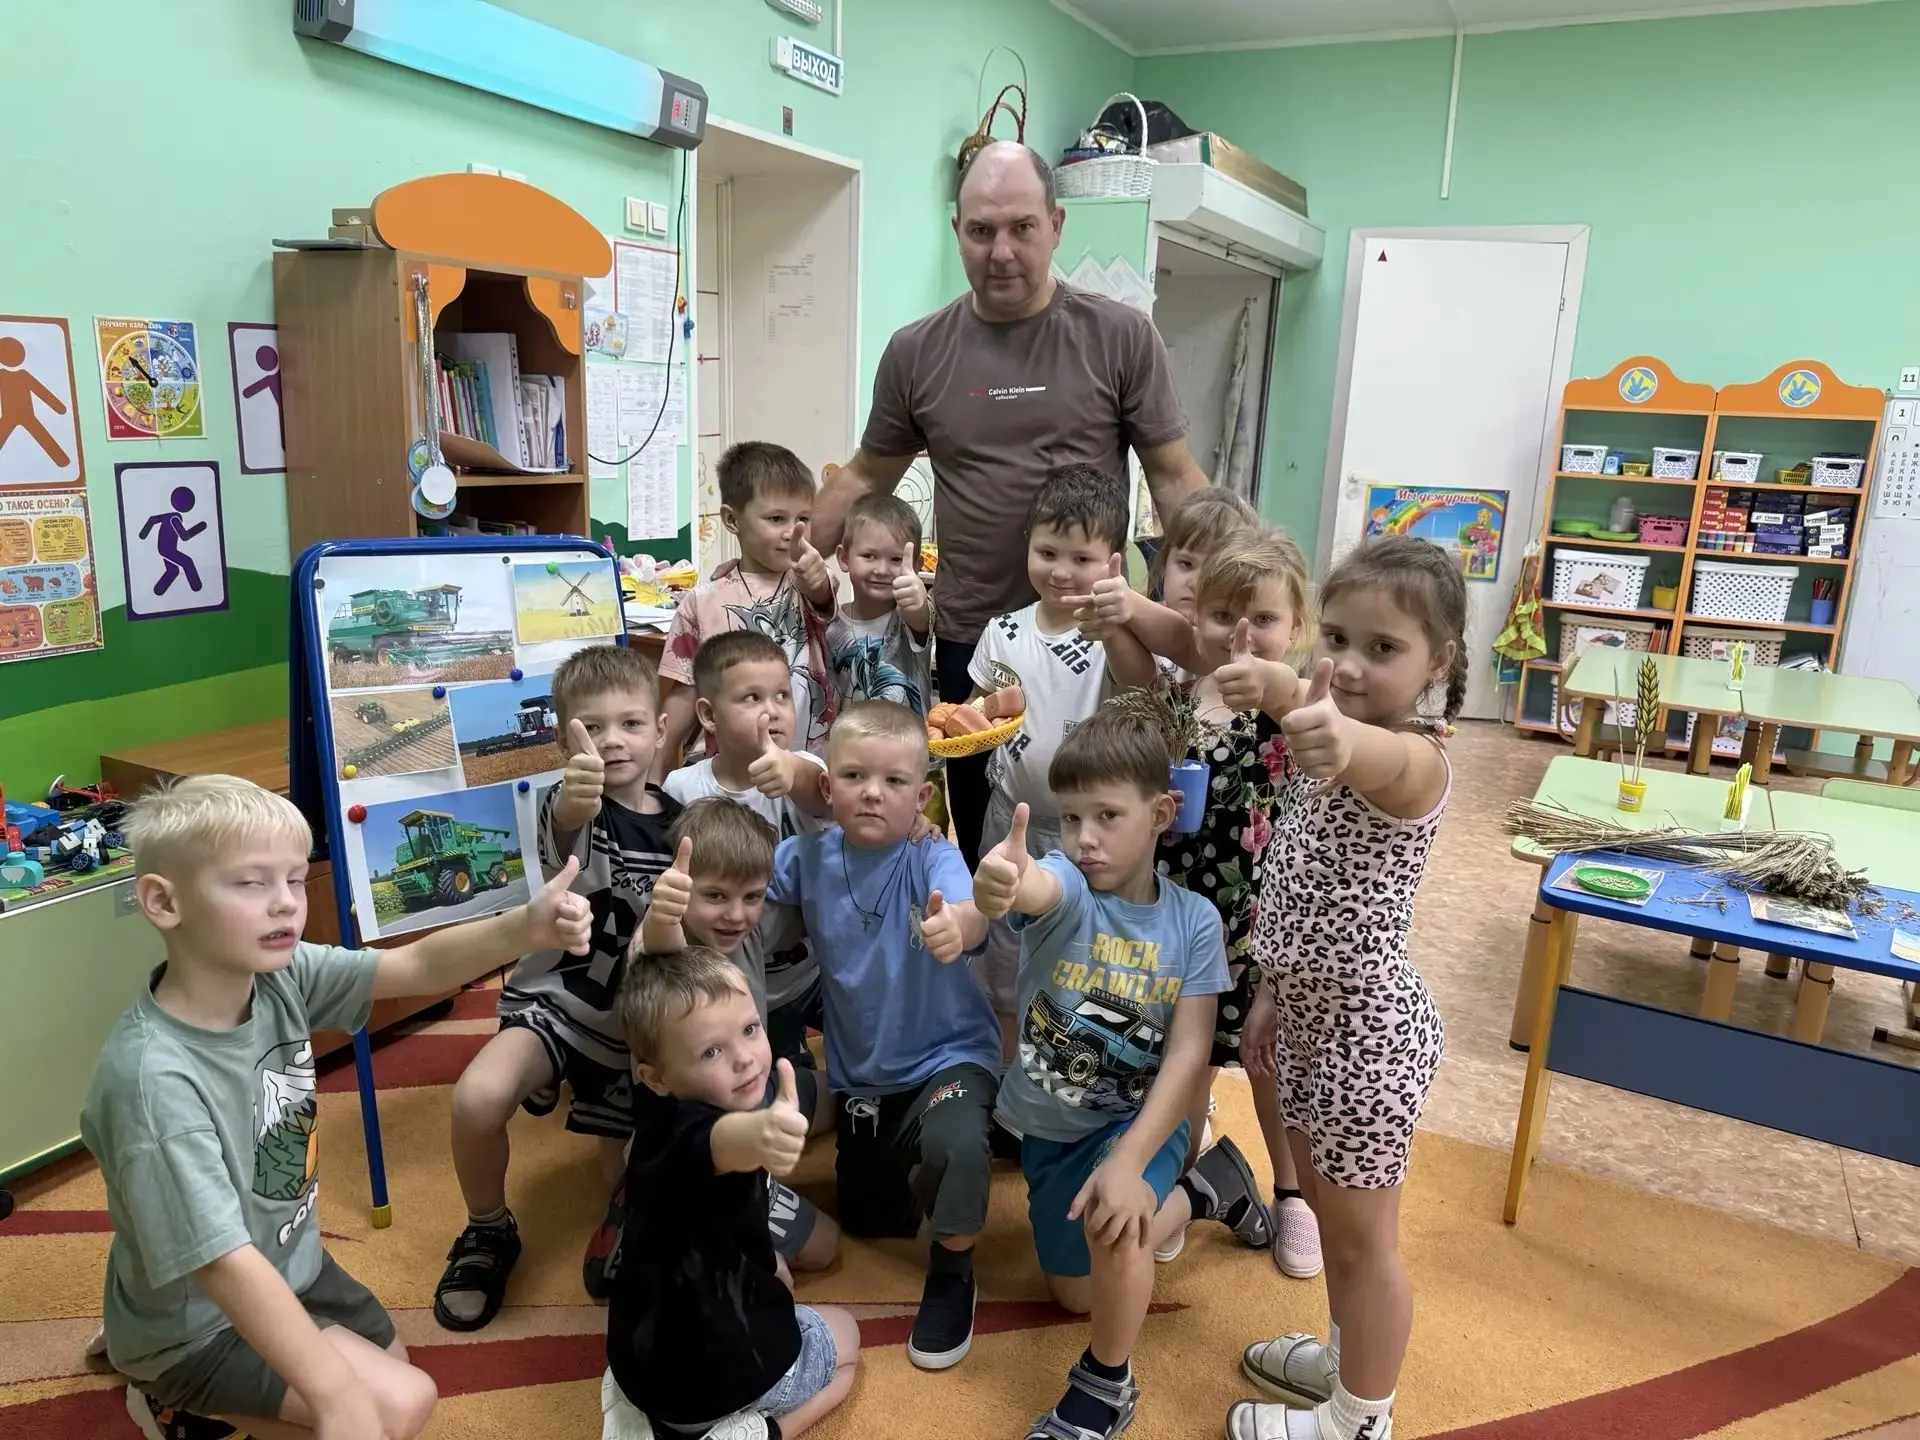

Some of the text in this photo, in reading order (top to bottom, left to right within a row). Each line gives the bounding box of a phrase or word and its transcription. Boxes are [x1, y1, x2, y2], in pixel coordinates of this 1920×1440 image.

[792, 48, 837, 87] ВЫХОД
[1902, 374, 1916, 383] 11
[988, 388, 1008, 396] Calvin
[1009, 386, 1025, 394] Klein
[6, 500, 35, 511] ТАКОЕ
[37, 498, 70, 509] ОСЕНЬ?
[1395, 489, 1480, 506] Мы дежурим
[1092, 933, 1162, 972] ROCK
[1052, 960, 1183, 1005] CRAWLER
